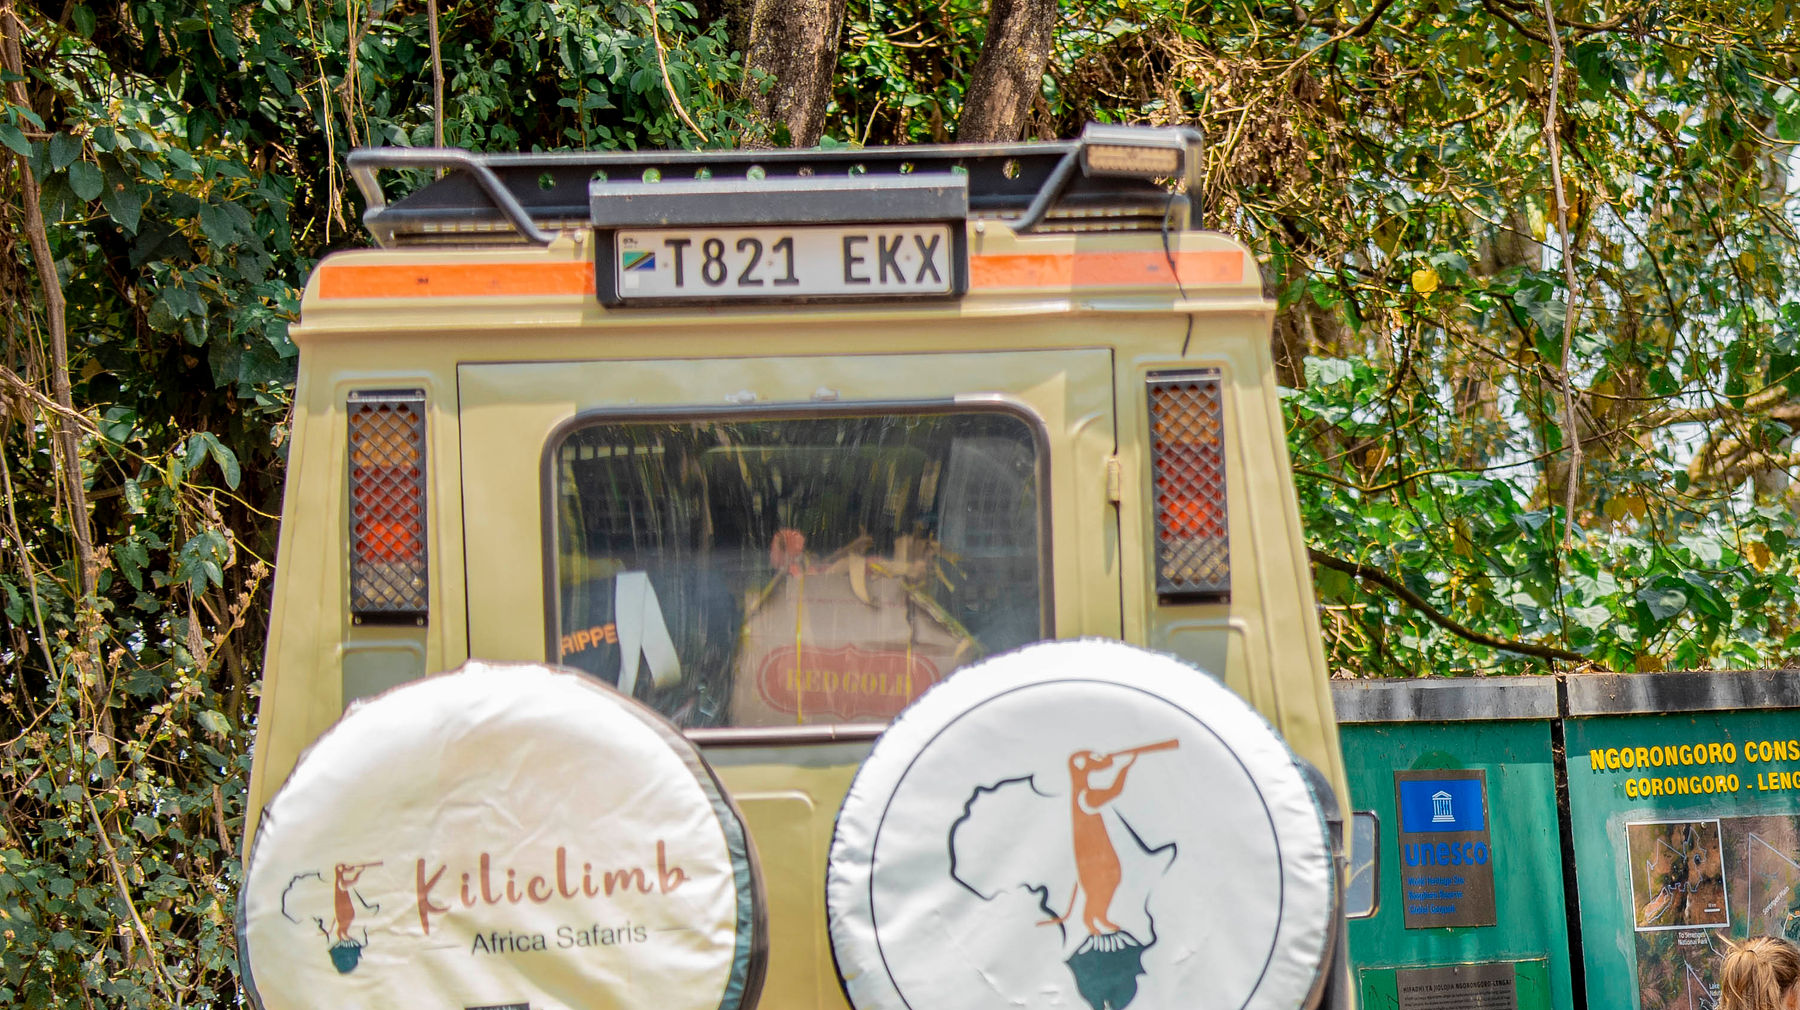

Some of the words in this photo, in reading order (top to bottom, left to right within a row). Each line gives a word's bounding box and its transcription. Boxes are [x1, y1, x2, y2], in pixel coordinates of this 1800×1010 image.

[664, 236, 800, 287] T821
[842, 234, 942, 285] EKX
[1590, 742, 1737, 771] NGORONGORO
[1625, 773, 1740, 797] GORONGORO
[1404, 841, 1489, 867] unesco
[416, 839, 691, 935] Kiliclimb
[471, 931, 548, 955] Africa
[556, 921, 648, 949] Safaris
